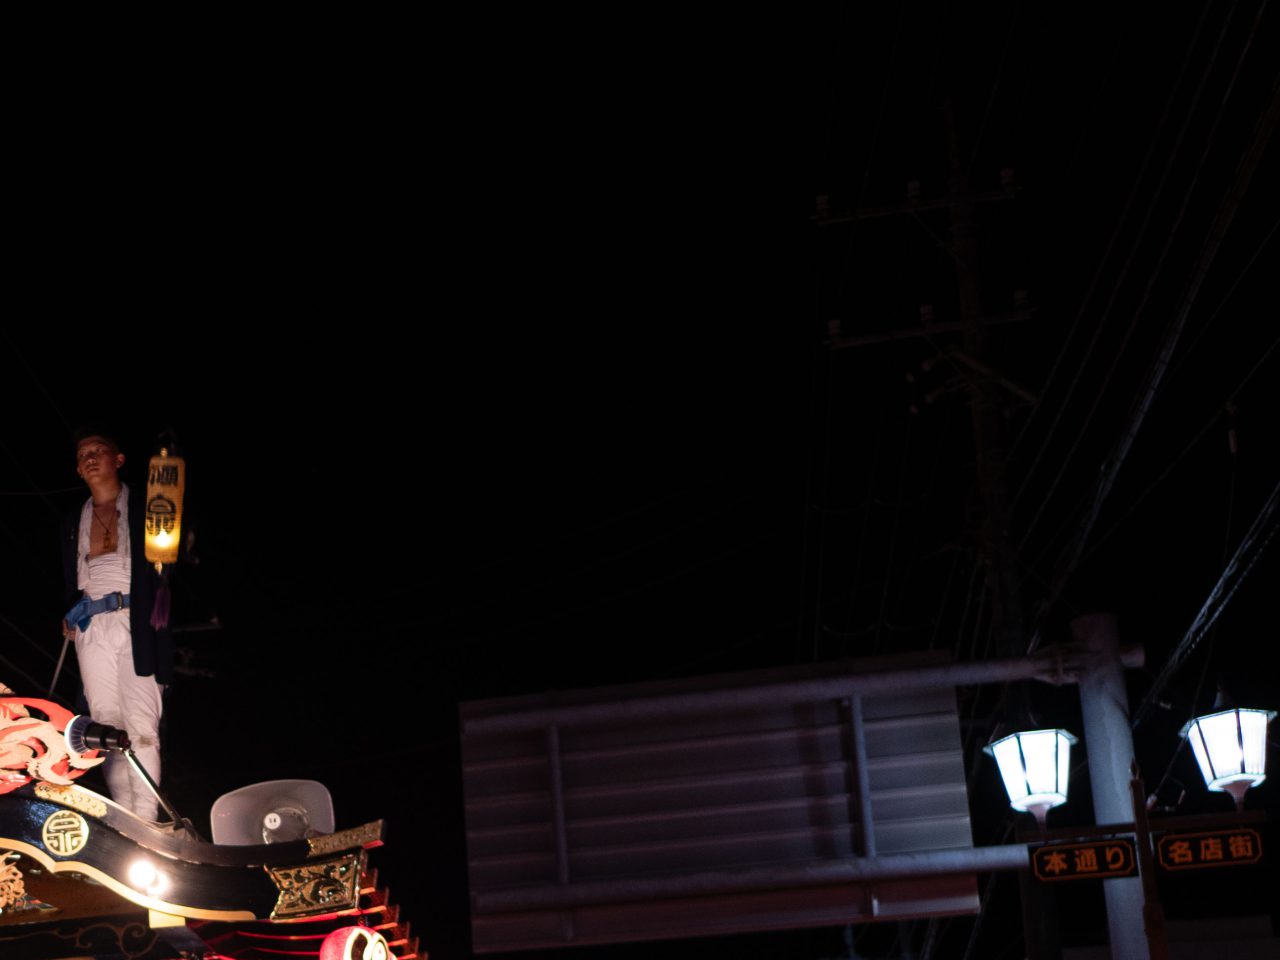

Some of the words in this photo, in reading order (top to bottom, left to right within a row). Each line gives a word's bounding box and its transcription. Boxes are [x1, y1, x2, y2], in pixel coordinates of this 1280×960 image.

[1043, 847, 1125, 875] 本通り
[1168, 835, 1253, 864] 名店街
